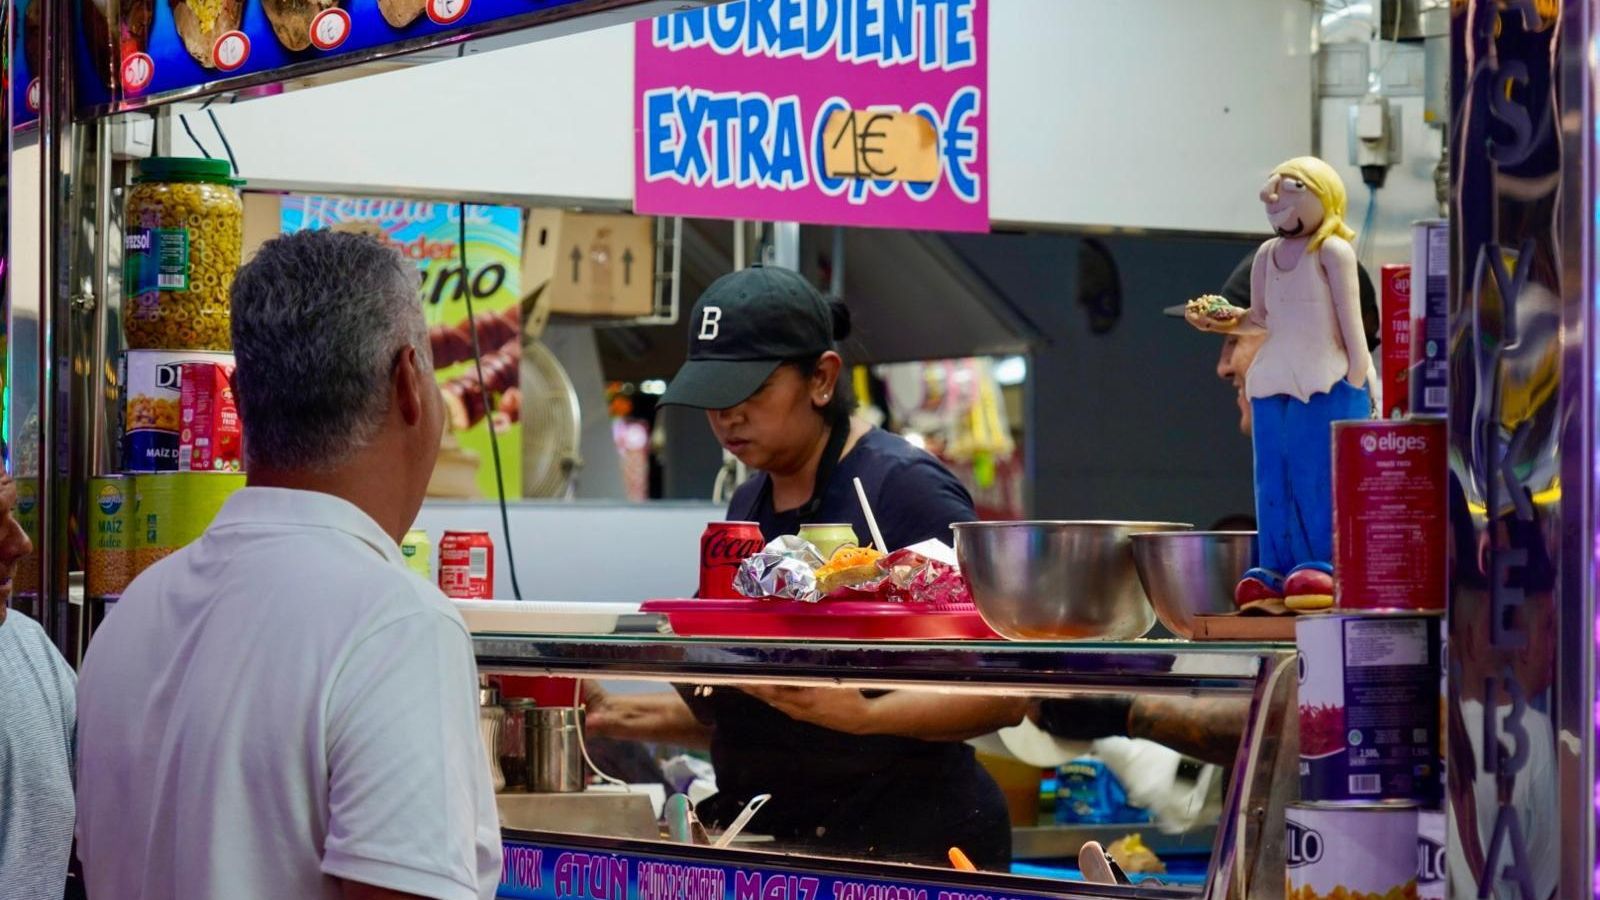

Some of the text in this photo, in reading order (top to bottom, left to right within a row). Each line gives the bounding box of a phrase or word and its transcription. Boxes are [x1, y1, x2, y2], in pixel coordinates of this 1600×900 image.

[645, 86, 808, 190] EXTRA
[832, 111, 898, 179] 1€
[421, 263, 507, 305] no
[698, 306, 722, 340] B
[1379, 431, 1427, 455] eliges
[510, 846, 543, 889] YORK
[554, 852, 629, 900] ATUN
